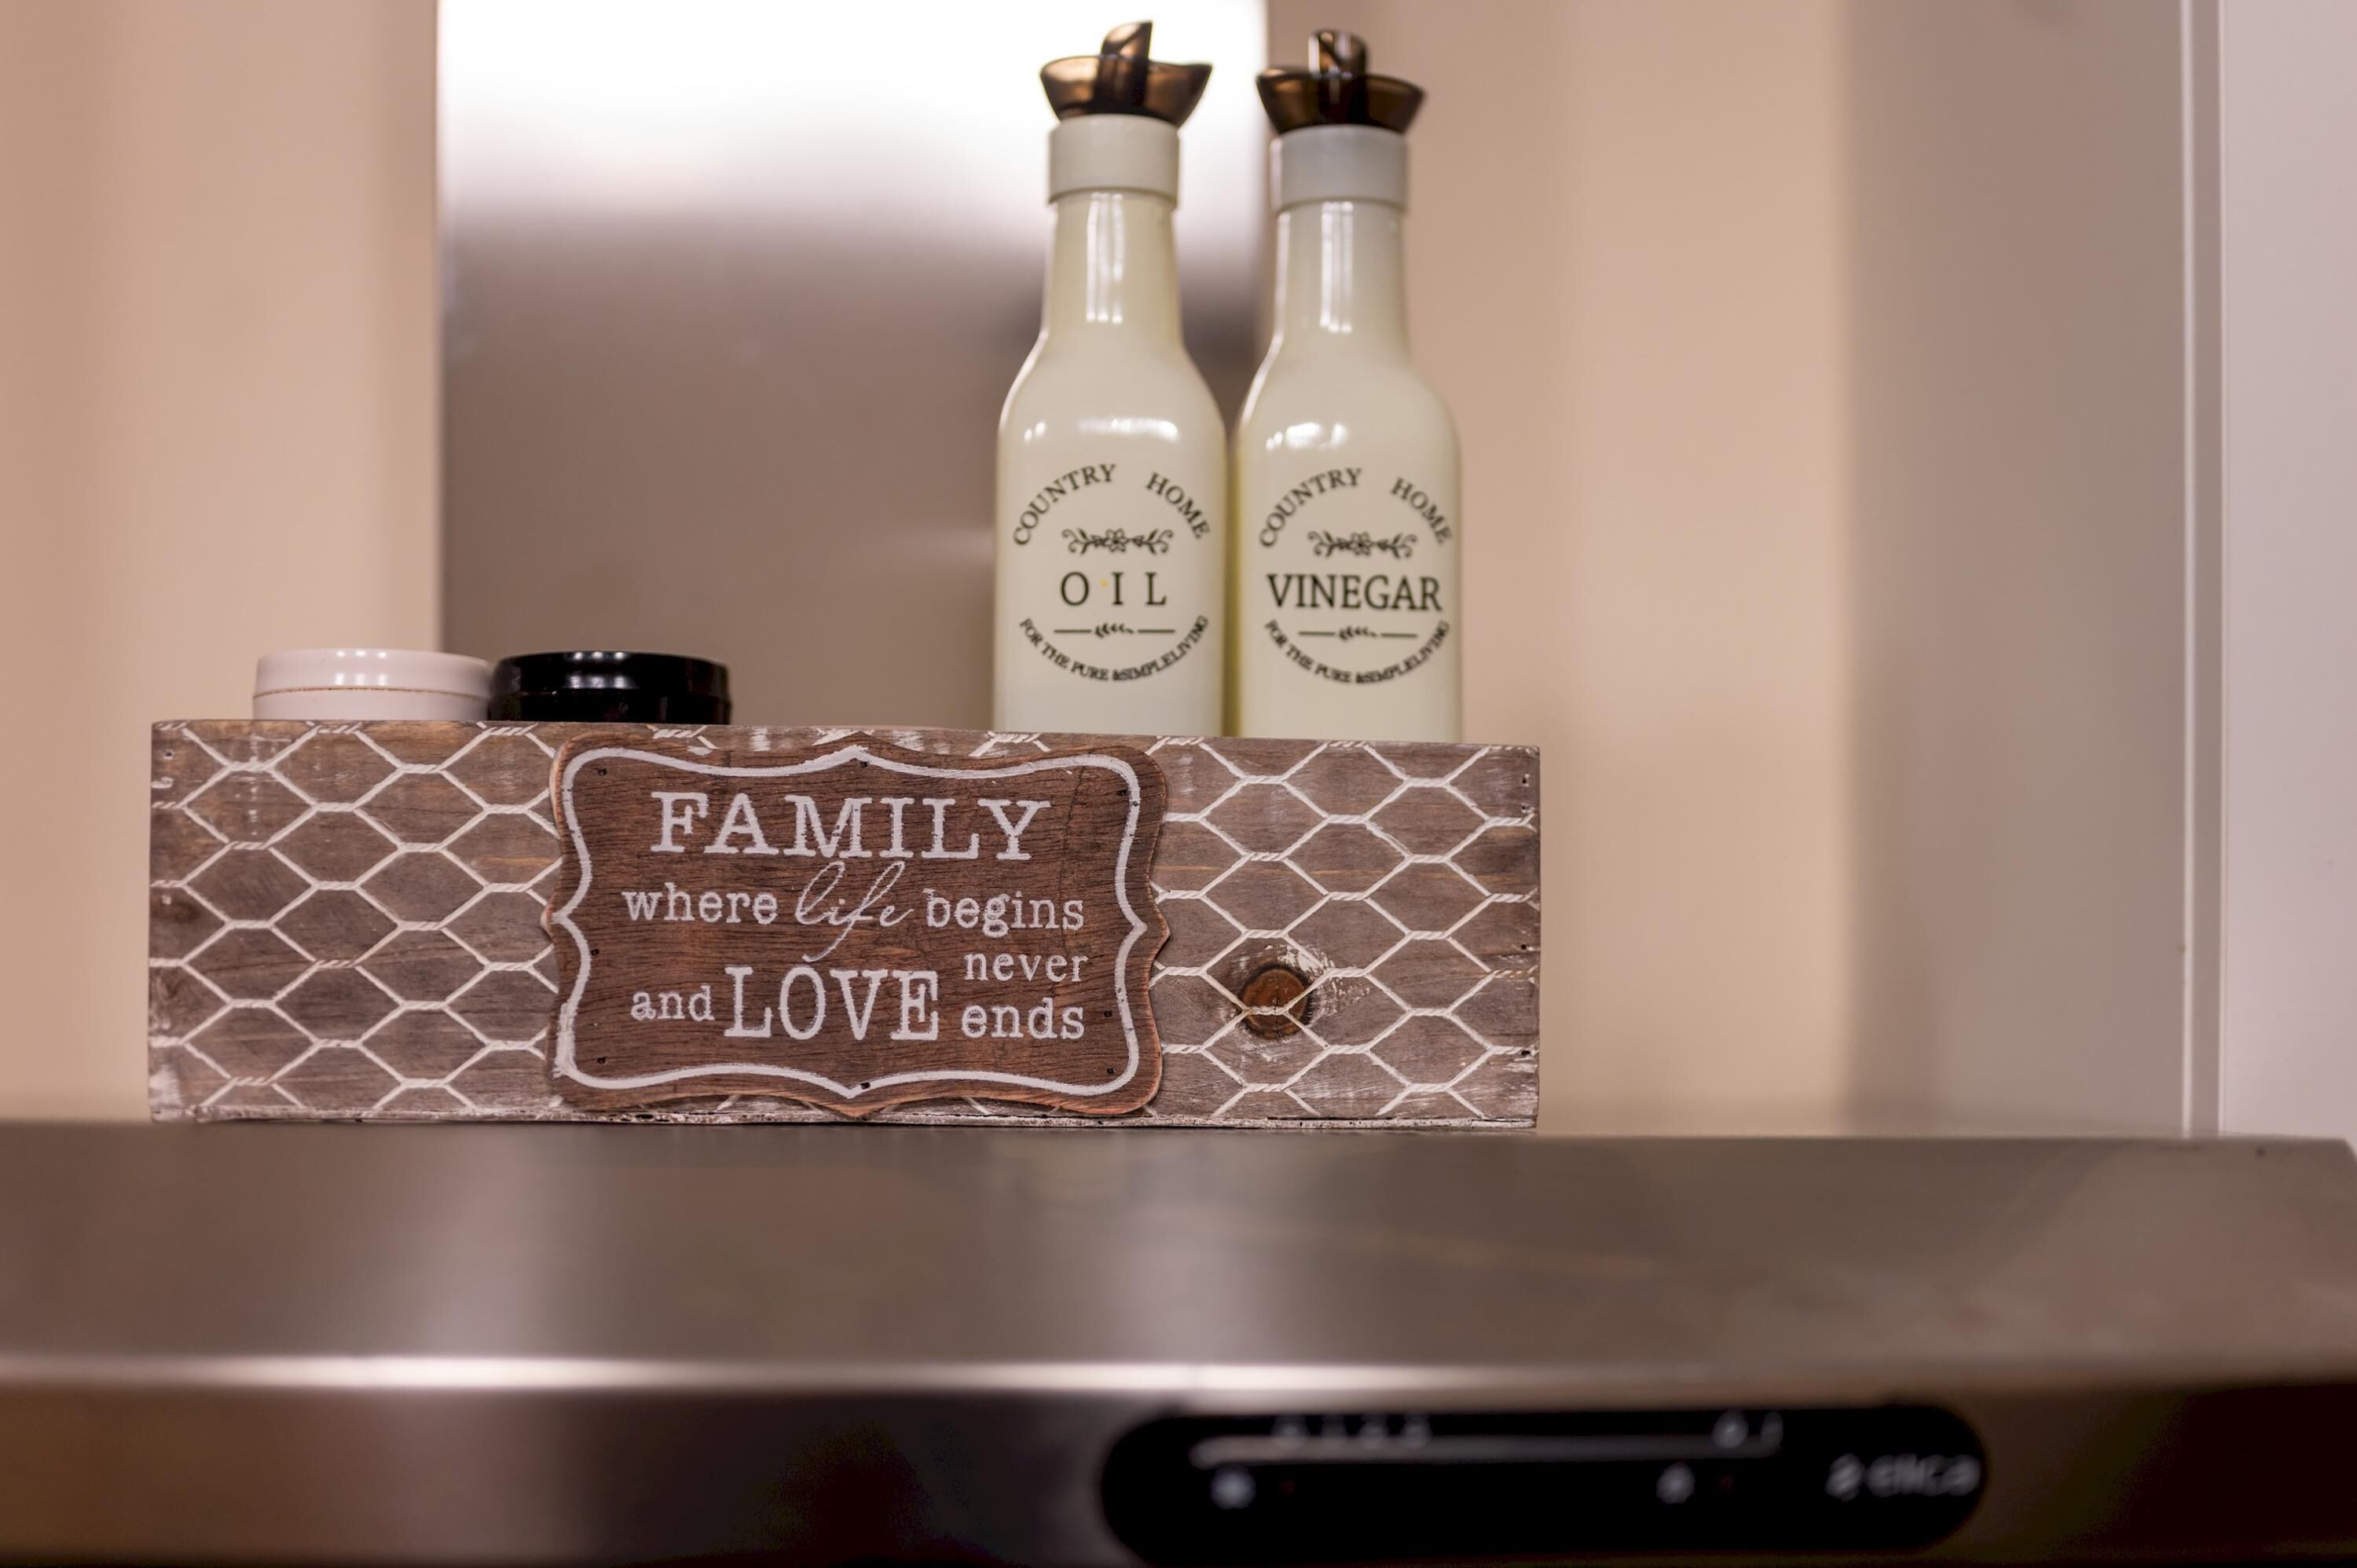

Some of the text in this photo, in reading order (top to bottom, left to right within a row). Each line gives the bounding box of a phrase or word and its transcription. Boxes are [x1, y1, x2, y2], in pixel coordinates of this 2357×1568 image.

[1014, 464, 1211, 546] COUNTRY HOME
[1259, 467, 1452, 548] COUNTRY HOME
[1266, 573, 1443, 612] VINEGAR
[1020, 617, 1043, 647] FOR
[1042, 642, 1071, 669] THE
[1070, 661, 1109, 681] PURE
[1265, 619, 1288, 648] FOR
[1285, 643, 1315, 670] THE
[1314, 663, 1352, 683] PURE
[651, 791, 1051, 861] FAMILY
[621, 860, 1084, 962] where life begins
[963, 953, 1088, 982] never
[630, 965, 1084, 1041] and LOVE ends
